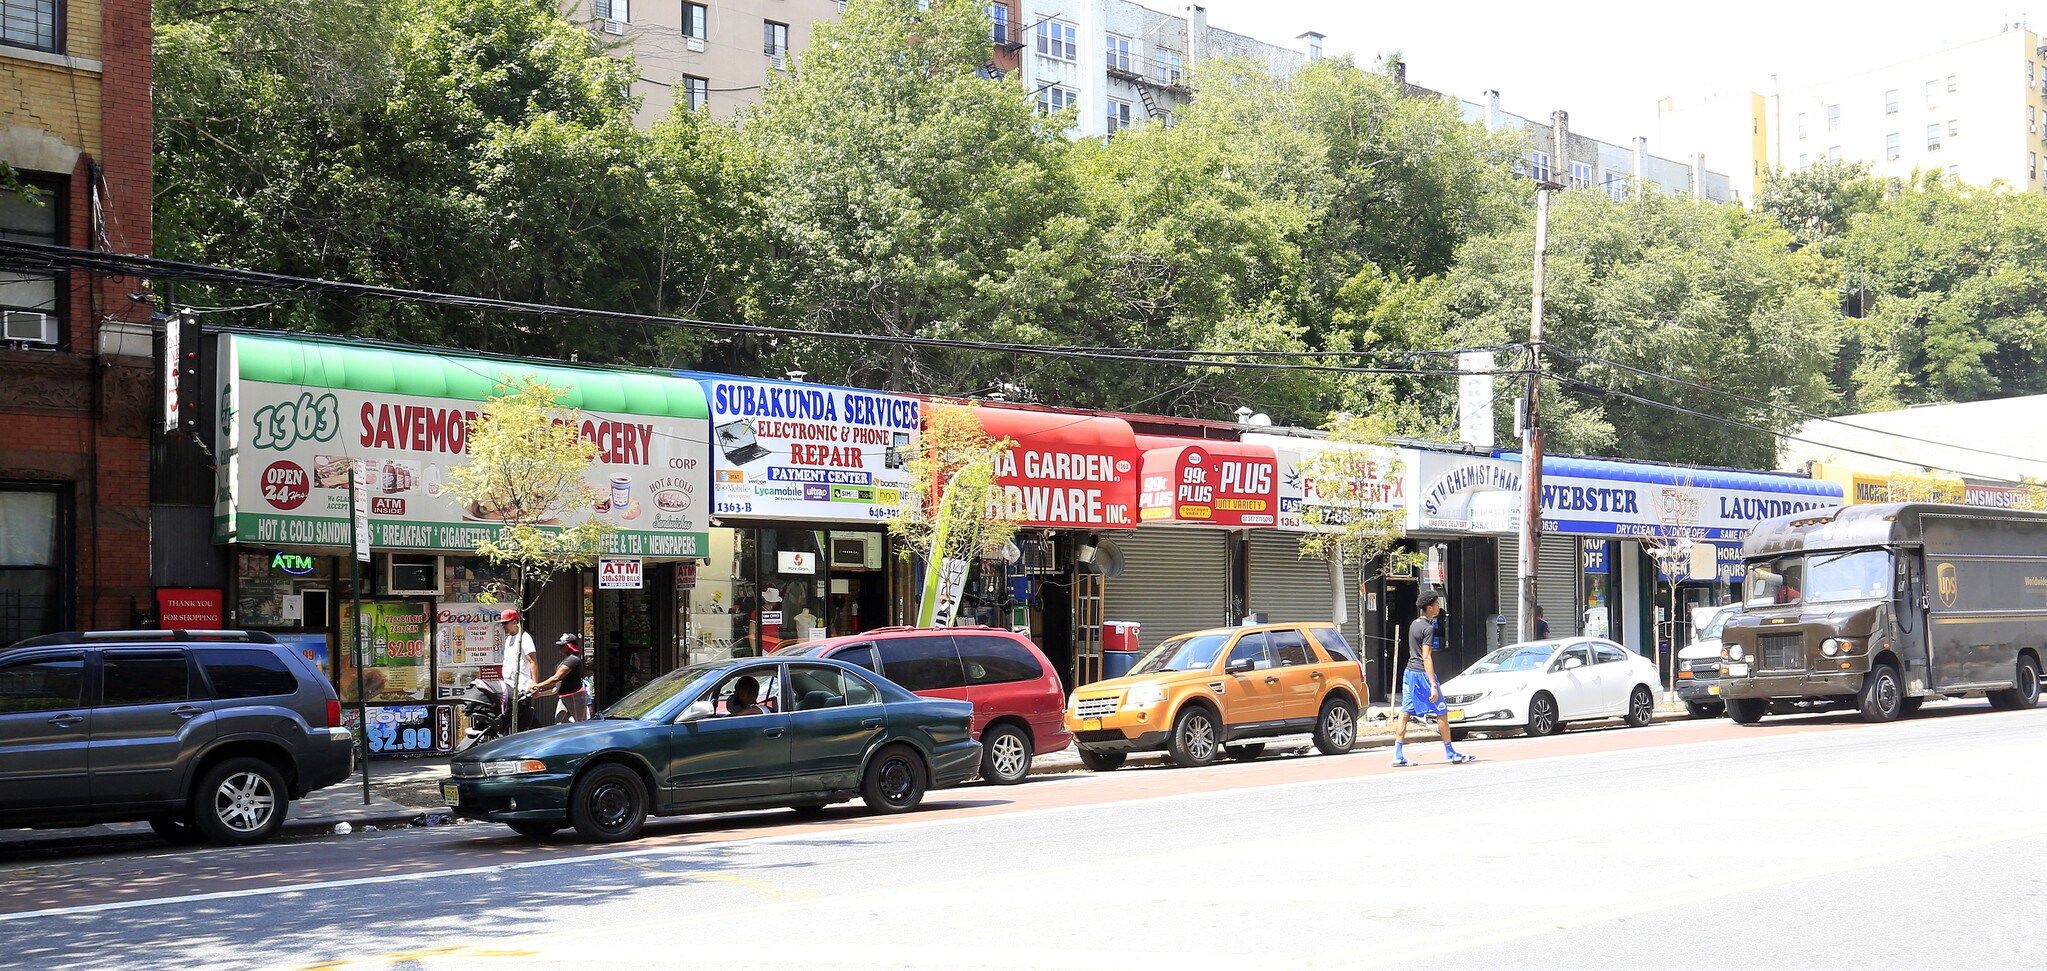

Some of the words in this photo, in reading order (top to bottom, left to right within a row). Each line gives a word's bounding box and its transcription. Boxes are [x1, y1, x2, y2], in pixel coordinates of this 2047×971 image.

[716, 384, 837, 421] SUBAKUNDA
[845, 395, 919, 430] SERVICES
[253, 392, 340, 451] 1363
[758, 420, 837, 442] ELECTRONIC
[841, 426, 850, 443] &
[853, 429, 890, 446] PHONE
[669, 457, 697, 470] CORP
[790, 443, 864, 469] REPAIR
[1024, 450, 1114, 482] GARDEN
[267, 468, 303, 485] OPEN
[772, 467, 828, 482] PAYMENT
[829, 471, 869, 485] CENTER
[1220, 462, 1272, 494] PLUS
[1447, 465, 1490, 494] CHEMIST
[1493, 467, 1523, 491] PHAR
[265, 485, 289, 503] 24
[649, 478, 667, 494] HOT
[667, 478, 673, 487] &
[674, 478, 694, 494] COLD
[755, 486, 802, 496] Lycamobile
[1178, 485, 1213, 502] PLUS
[1346, 481, 1391, 503] RENT
[376, 499, 402, 509] ATM
[718, 502, 752, 512] 1363-B
[985, 485, 1102, 523] RDWARE
[1106, 505, 1131, 524] INC.
[1139, 491, 1174, 507] PLUS
[1233, 500, 1262, 509] VARIETY
[1541, 485, 1638, 513] WEBSTER
[1720, 496, 1838, 519] LAUNDROM
[1965, 489, 2032, 509] ANSMISSIONS
[652, 514, 693, 529] Sandwiches
[1281, 518, 1300, 527] 1363
[258, 519, 278, 540] HOT
[280, 520, 287, 540] &
[290, 521, 314, 542] COLD
[316, 522, 374, 545] SANDWIS
[382, 524, 432, 547] BREAKFAST
[440, 527, 491, 547] CIGARETTES
[621, 535, 627, 554] &
[628, 535, 642, 554] TEA
[650, 535, 696, 554] NEWSPAPERS
[1616, 523, 1632, 535] DRY
[1632, 525, 1656, 536] CLEAN
[1690, 528, 1705, 537] OFF
[1720, 530, 1739, 539] SAME
[271, 555, 312, 568] ATM
[1717, 548, 1743, 560] HORAS
[604, 563, 639, 574] ATM
[678, 565, 695, 577] ATM
[1661, 561, 1687, 575] OPEN
[1940, 577, 1955, 601] ups
[179, 614, 218, 622] SHOPPING
[437, 610, 481, 624] Coors
[483, 613, 501, 622] LIG
[387, 640, 424, 657] $2.99
[366, 708, 424, 724] Four
[368, 728, 432, 752] $2.99
